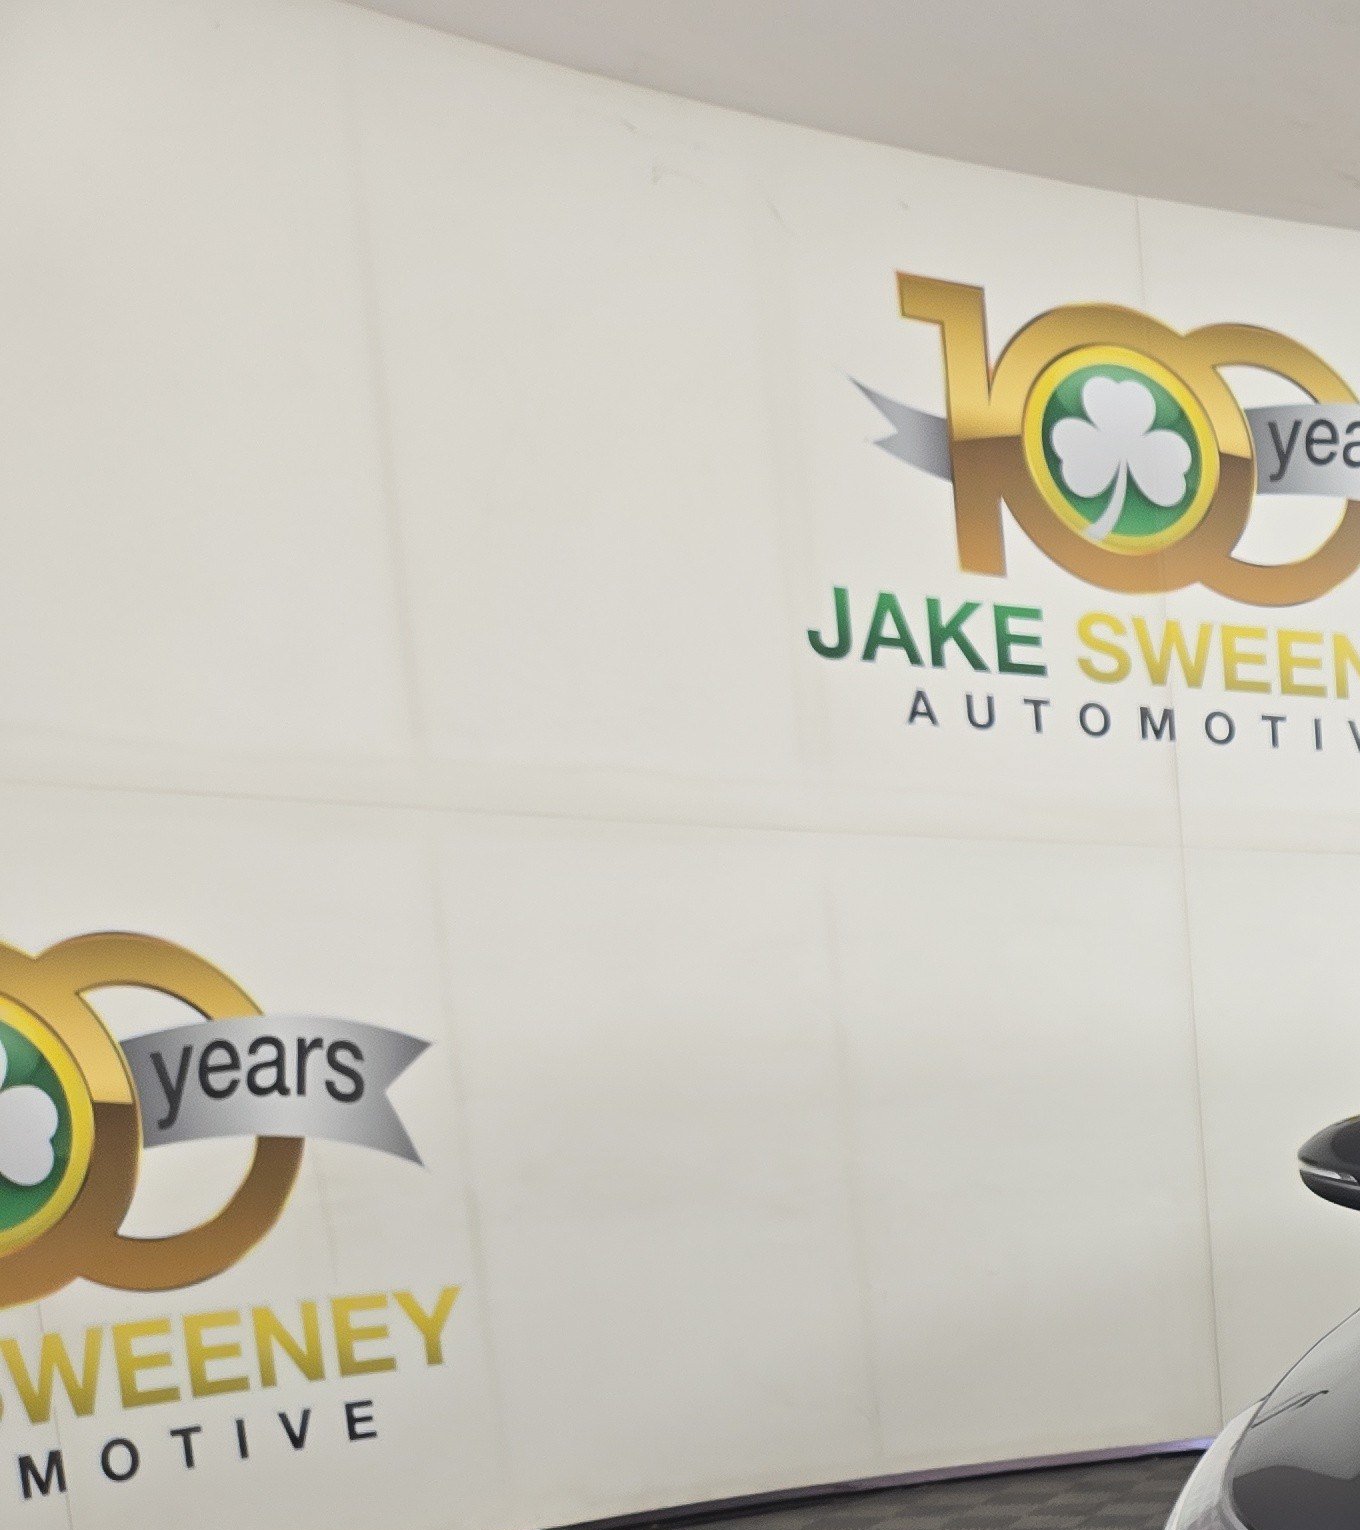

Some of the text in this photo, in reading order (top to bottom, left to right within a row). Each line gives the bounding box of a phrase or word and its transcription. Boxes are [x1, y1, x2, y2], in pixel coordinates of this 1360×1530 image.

[807, 586, 1048, 678] JAKE
[150, 1034, 365, 1130] years
[0, 1285, 461, 1425] WEENEY
